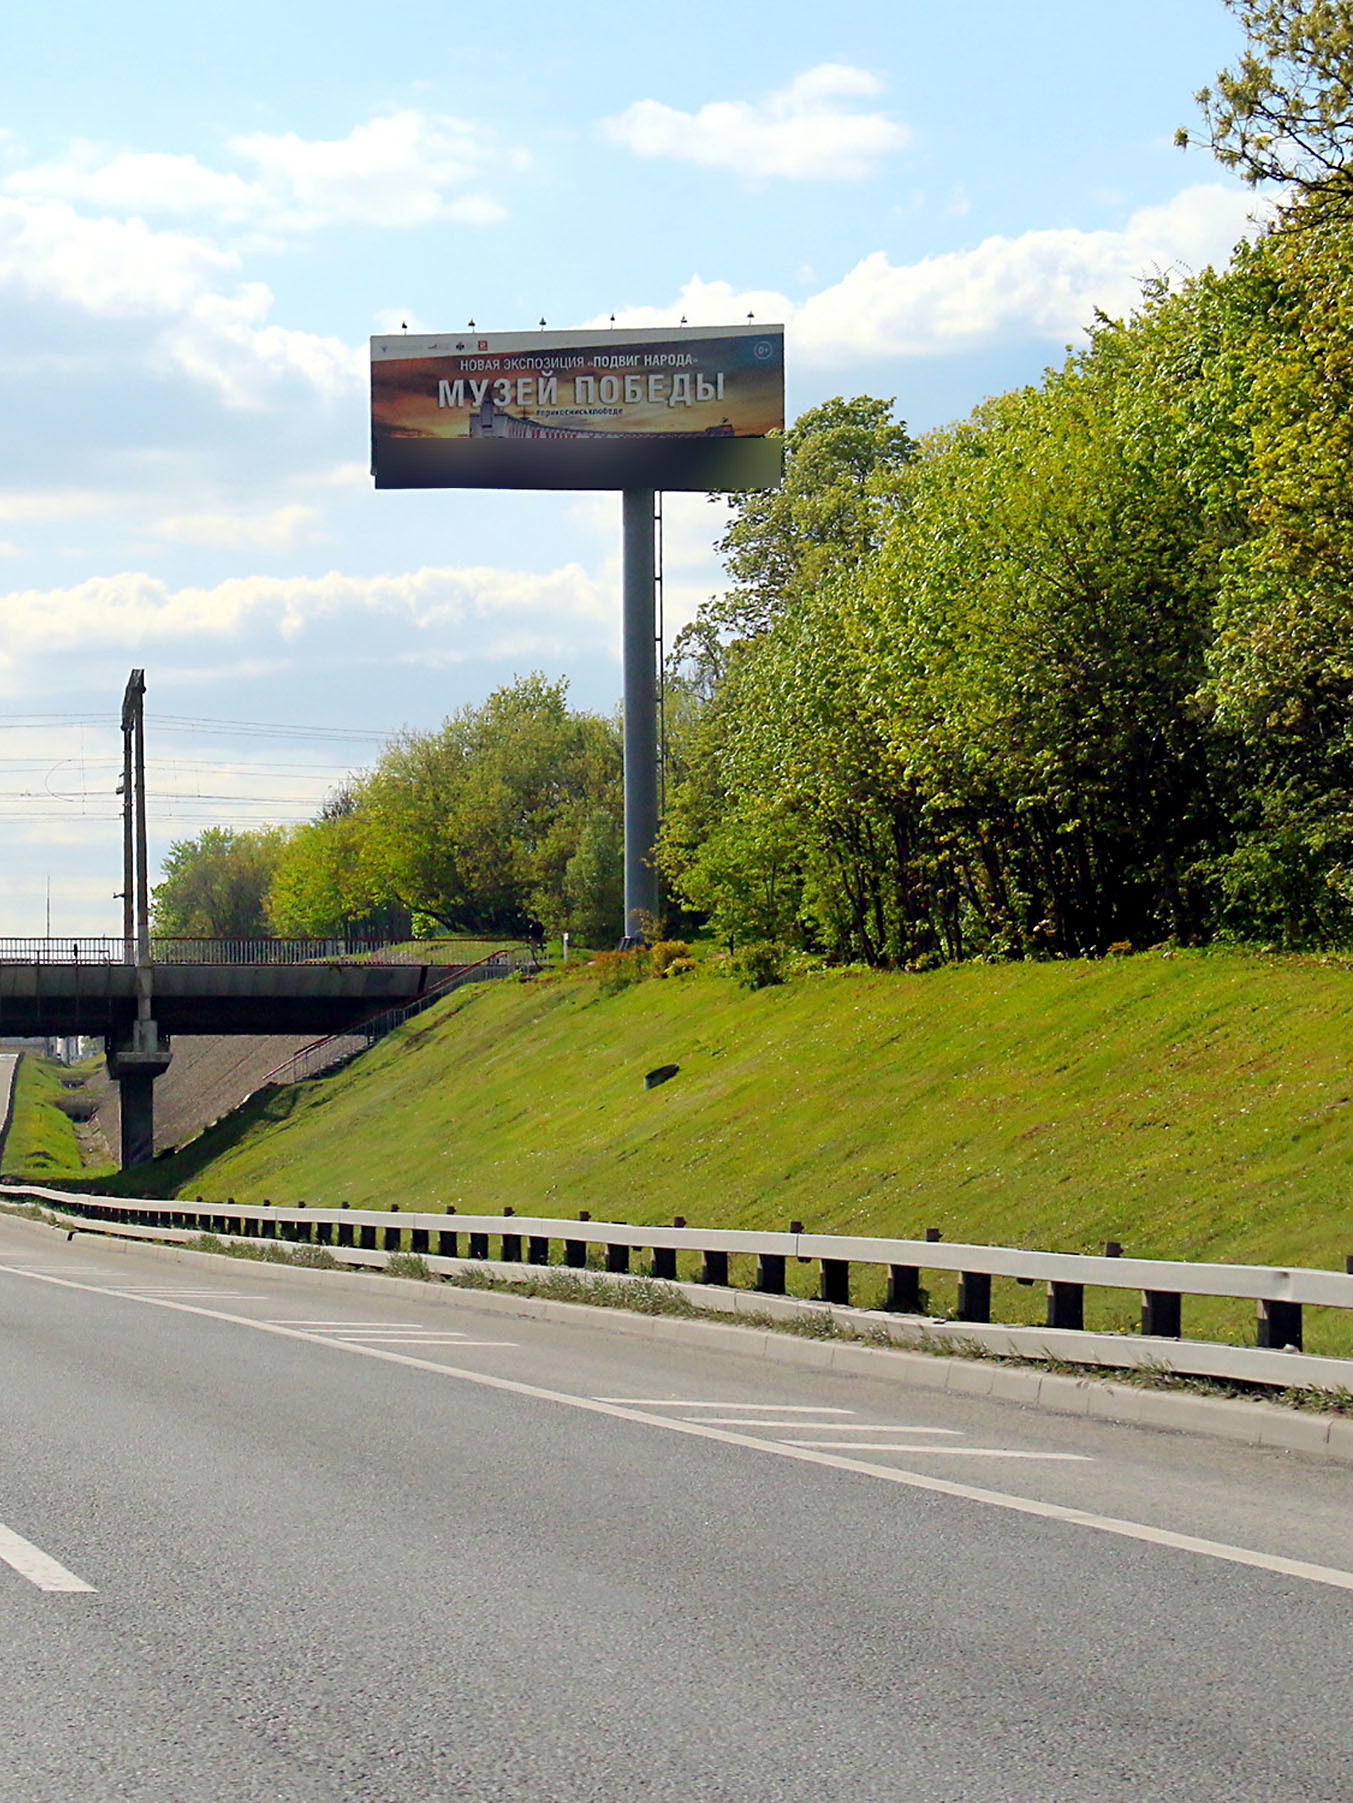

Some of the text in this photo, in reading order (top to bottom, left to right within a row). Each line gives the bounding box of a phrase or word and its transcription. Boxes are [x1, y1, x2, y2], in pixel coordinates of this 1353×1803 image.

[460, 360, 500, 371] НОВАЯ
[504, 356, 584, 370] ЭКСПОЗИЦИЯ
[438, 370, 725, 408] МУЗЕЙ ПОБЕДЫ
